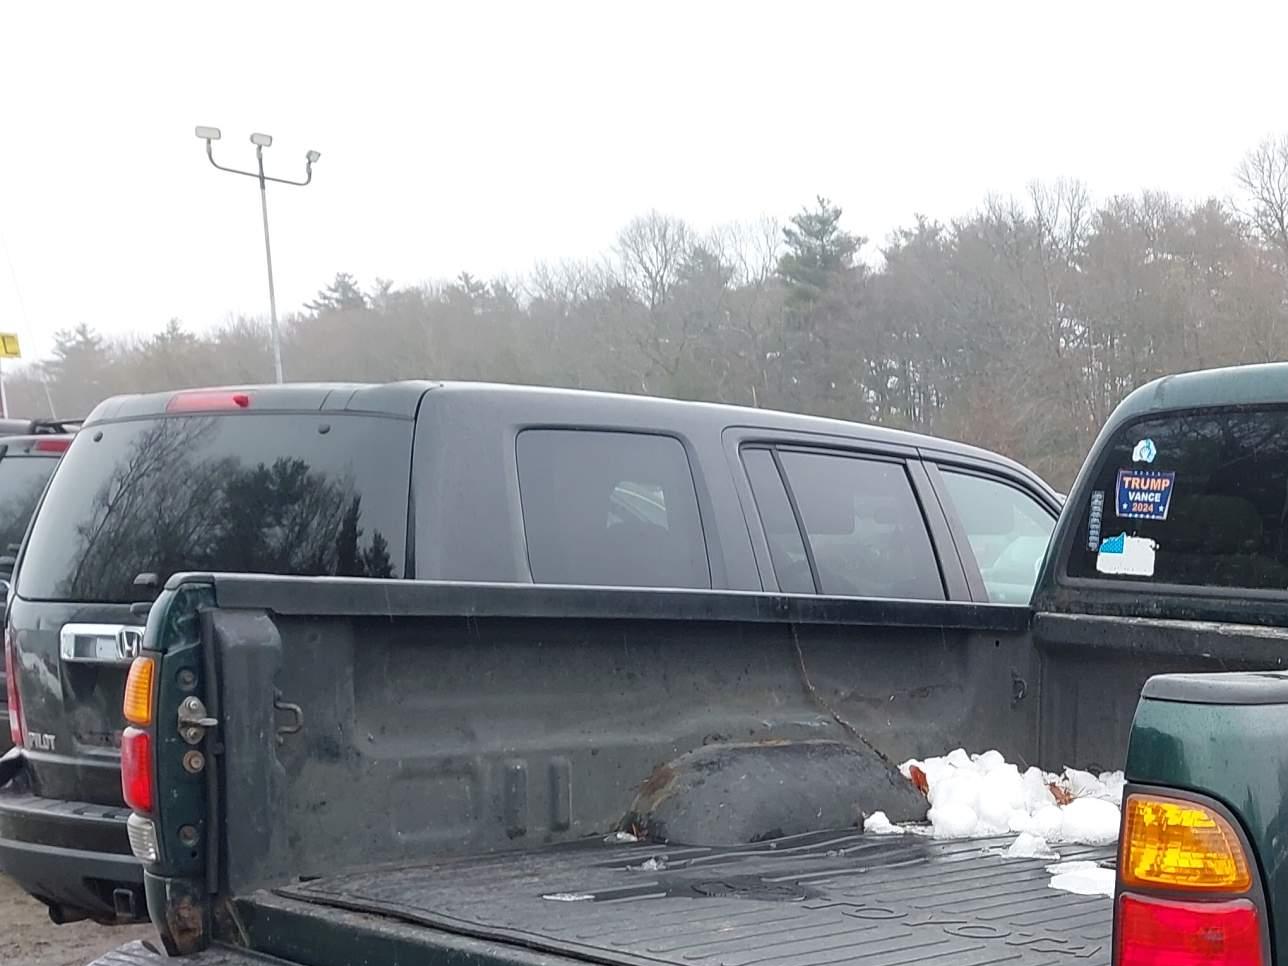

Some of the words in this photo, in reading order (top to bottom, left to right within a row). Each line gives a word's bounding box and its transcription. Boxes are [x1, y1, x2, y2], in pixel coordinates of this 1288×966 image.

[1122, 476, 1170, 491] TRUMP
[1128, 491, 1162, 503] VANCE
[1131, 502, 1154, 513] 2024
